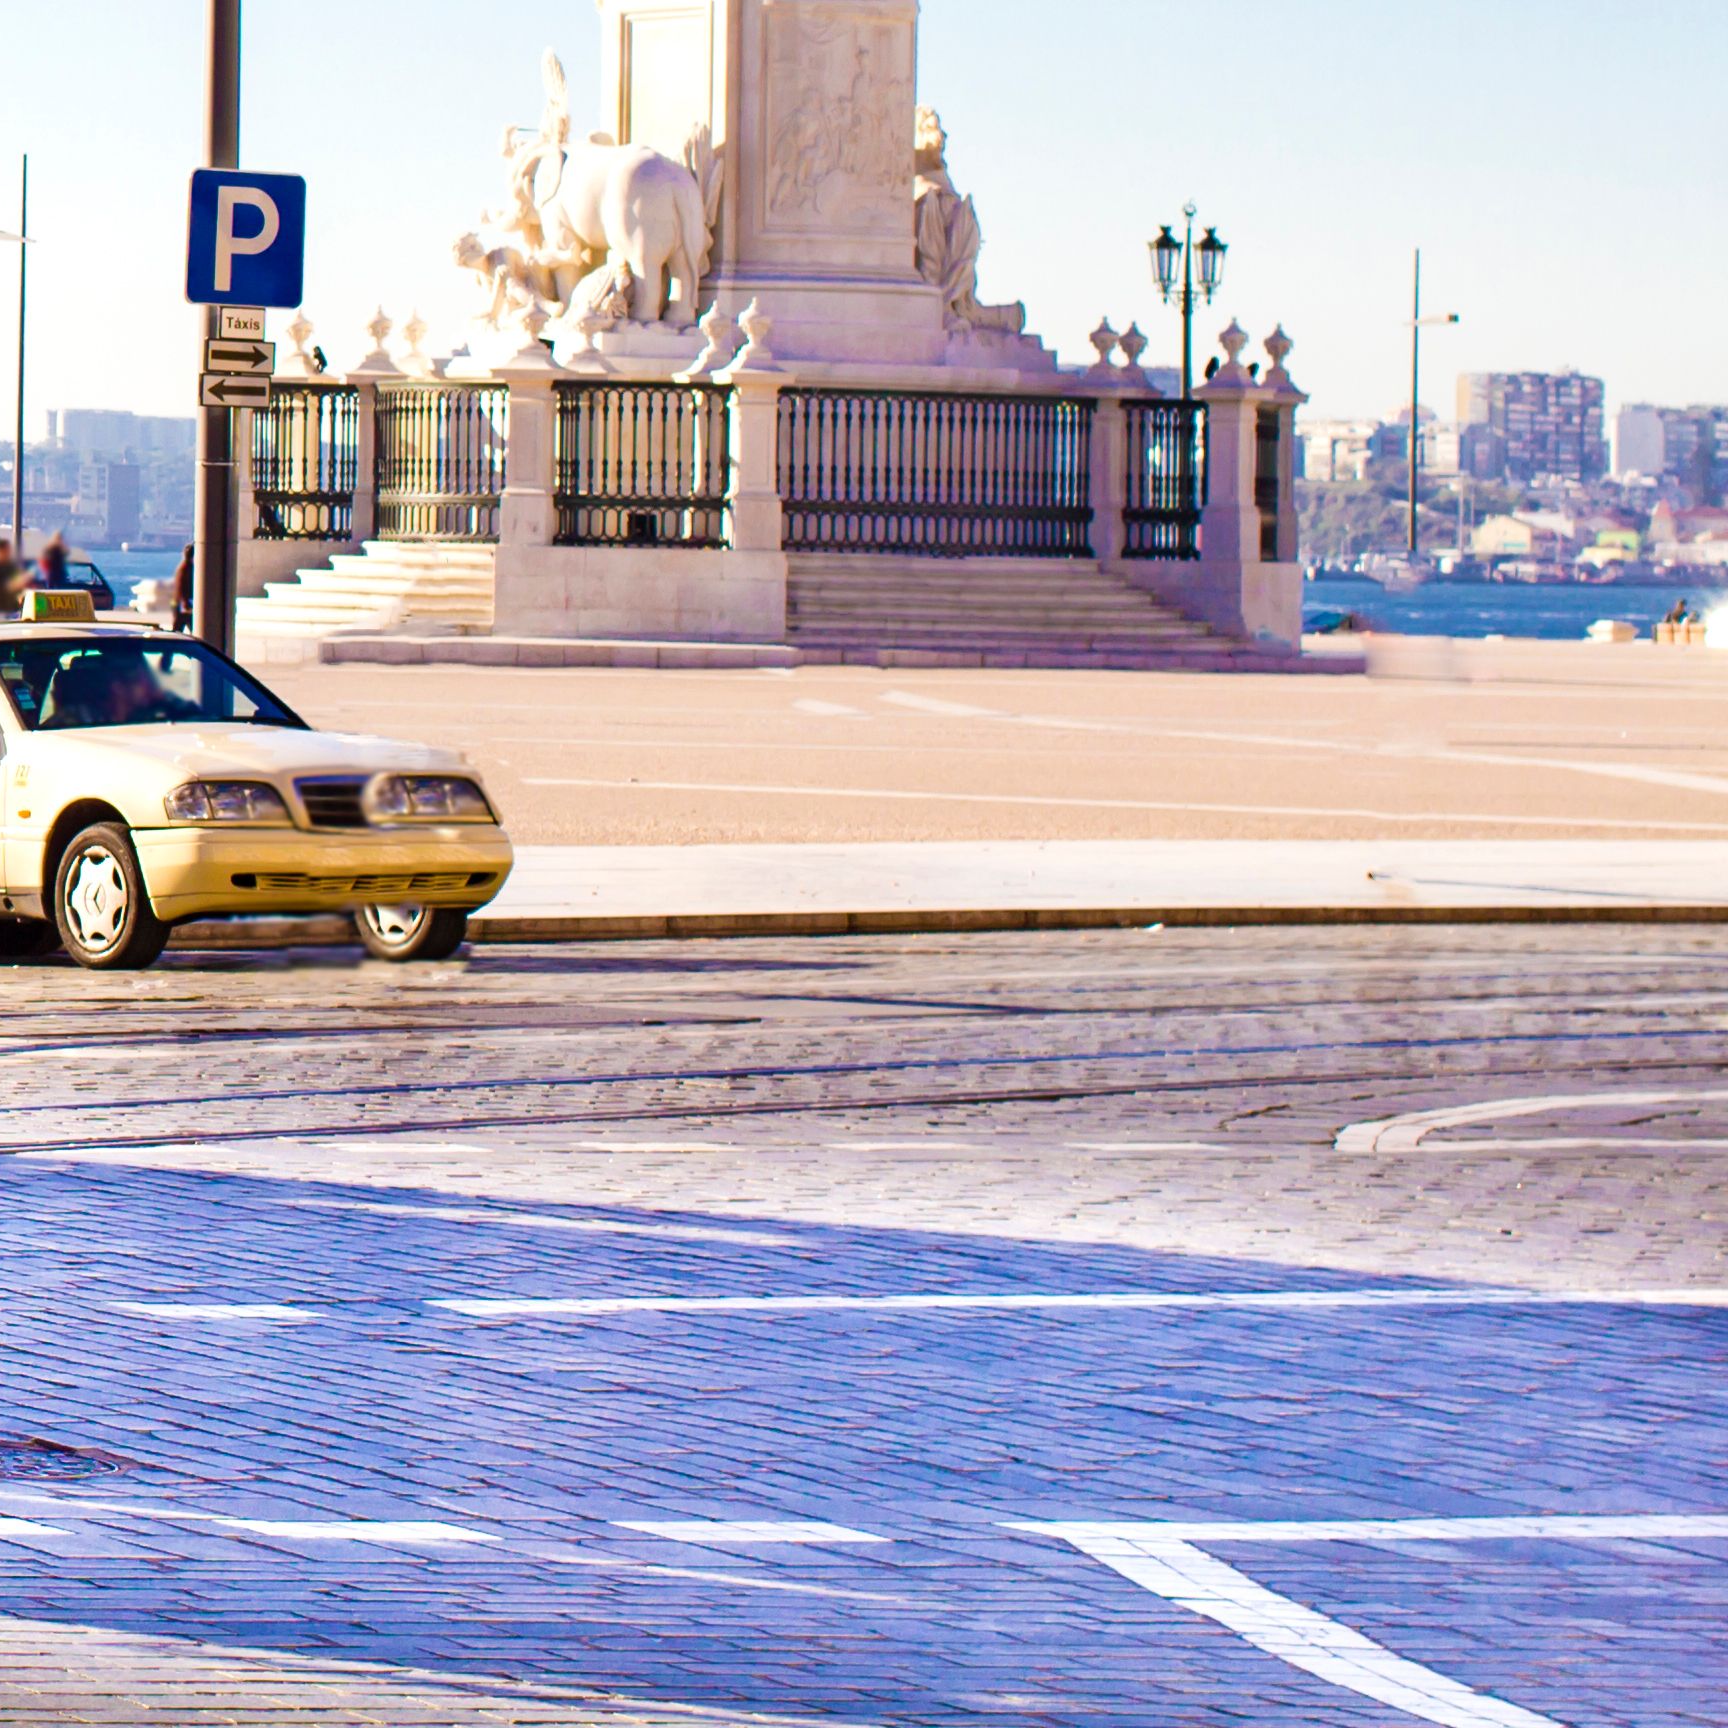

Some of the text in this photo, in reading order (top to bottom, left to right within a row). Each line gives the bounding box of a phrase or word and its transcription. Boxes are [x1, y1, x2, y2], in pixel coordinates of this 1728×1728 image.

[214, 185, 280, 292] P
[226, 316, 260, 331] Táxis
[47, 596, 77, 609] TAXI
